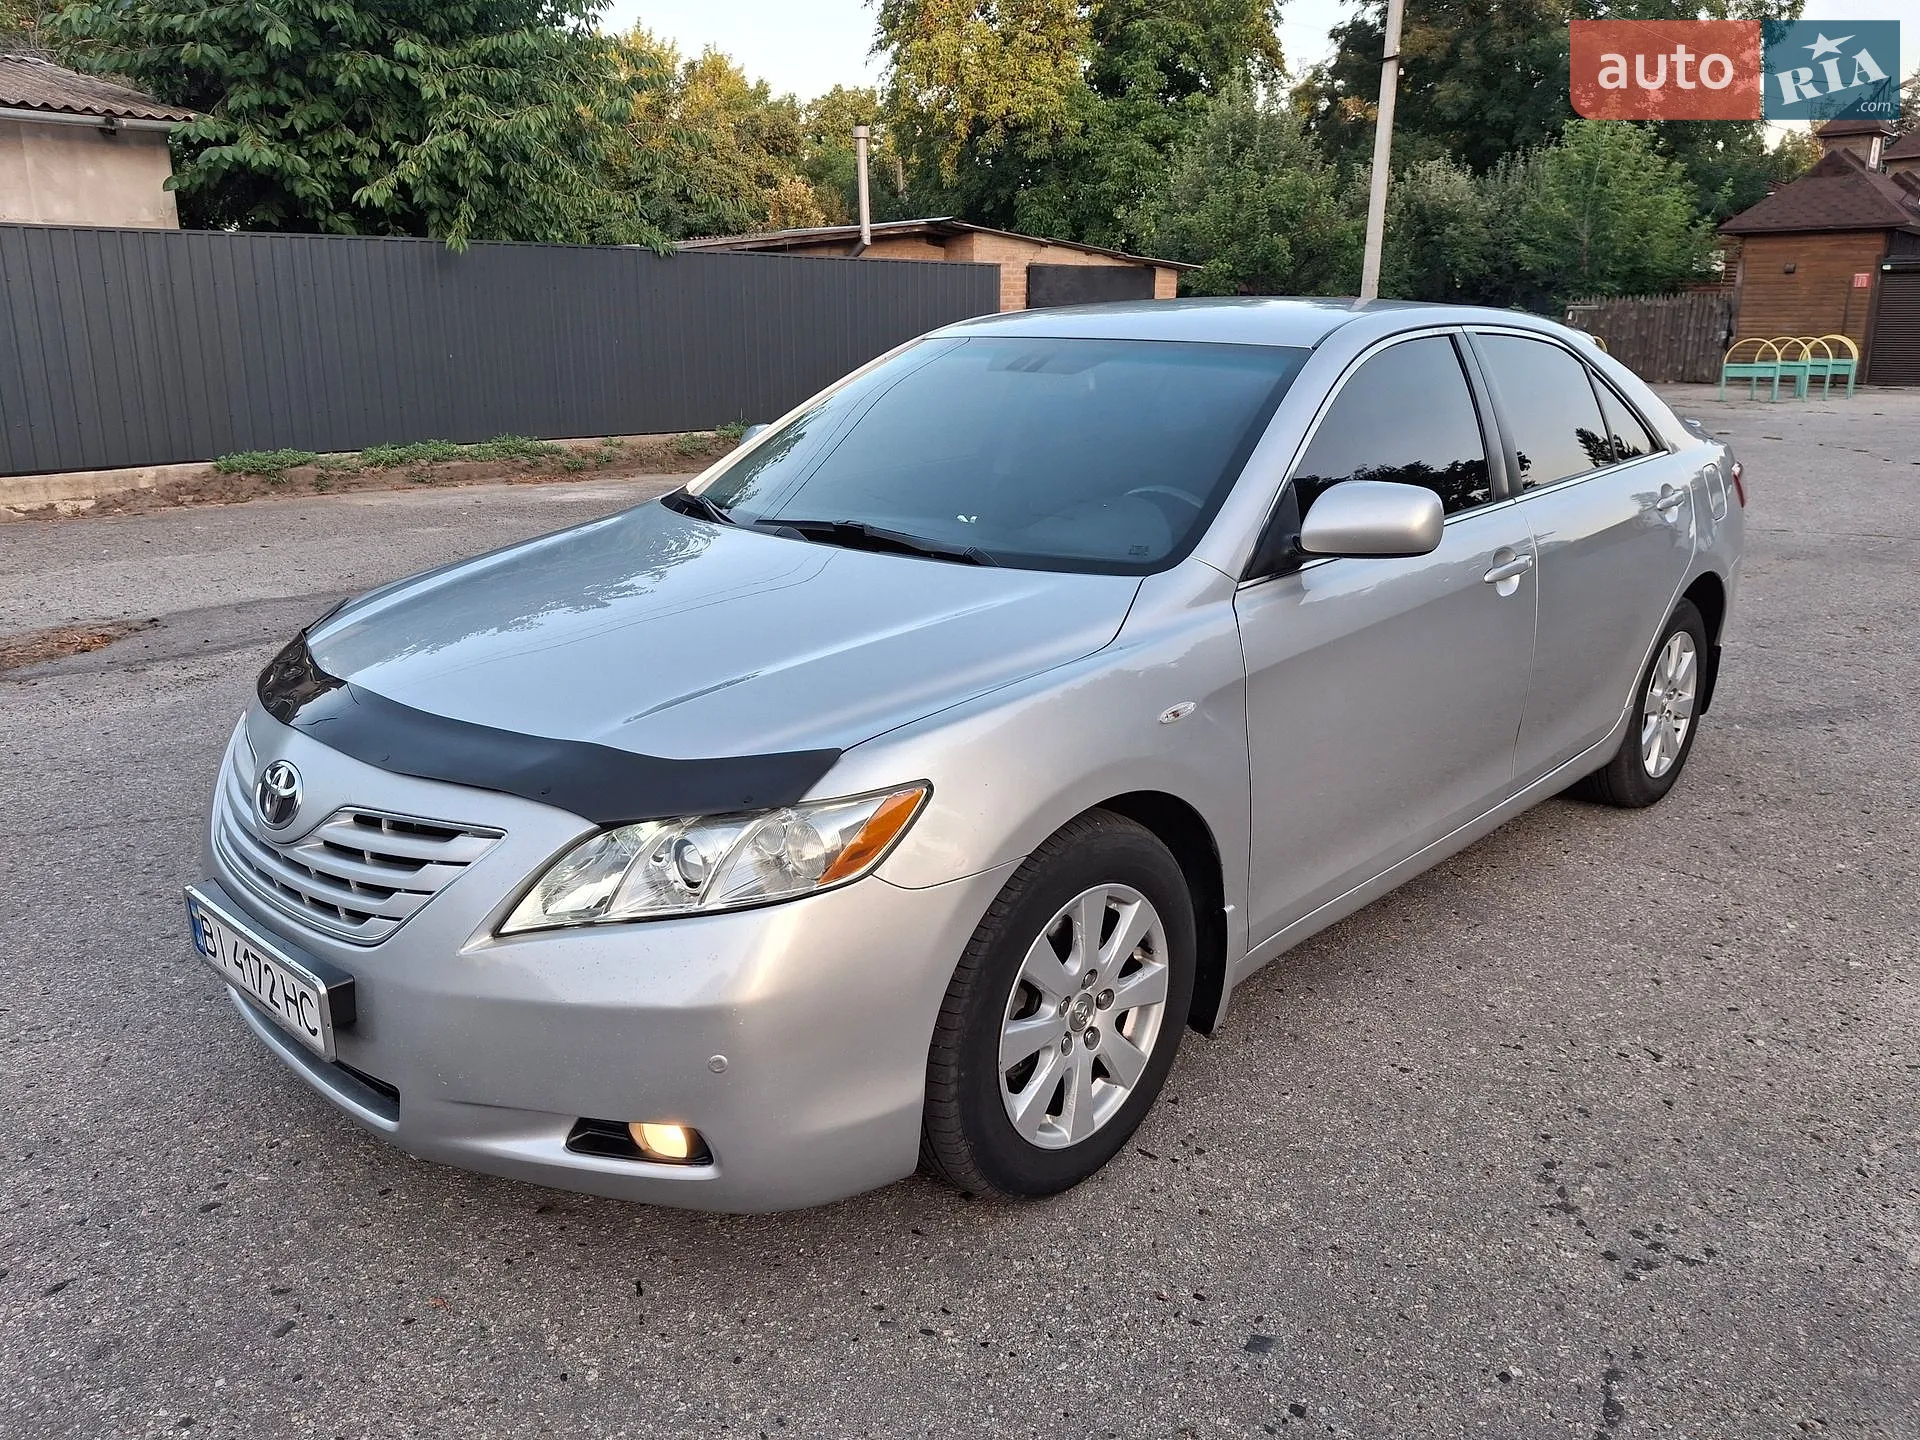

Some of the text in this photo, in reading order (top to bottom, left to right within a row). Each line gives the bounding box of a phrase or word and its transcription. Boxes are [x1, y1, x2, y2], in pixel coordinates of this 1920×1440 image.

[200, 913, 318, 1037] BI 4172 HC
